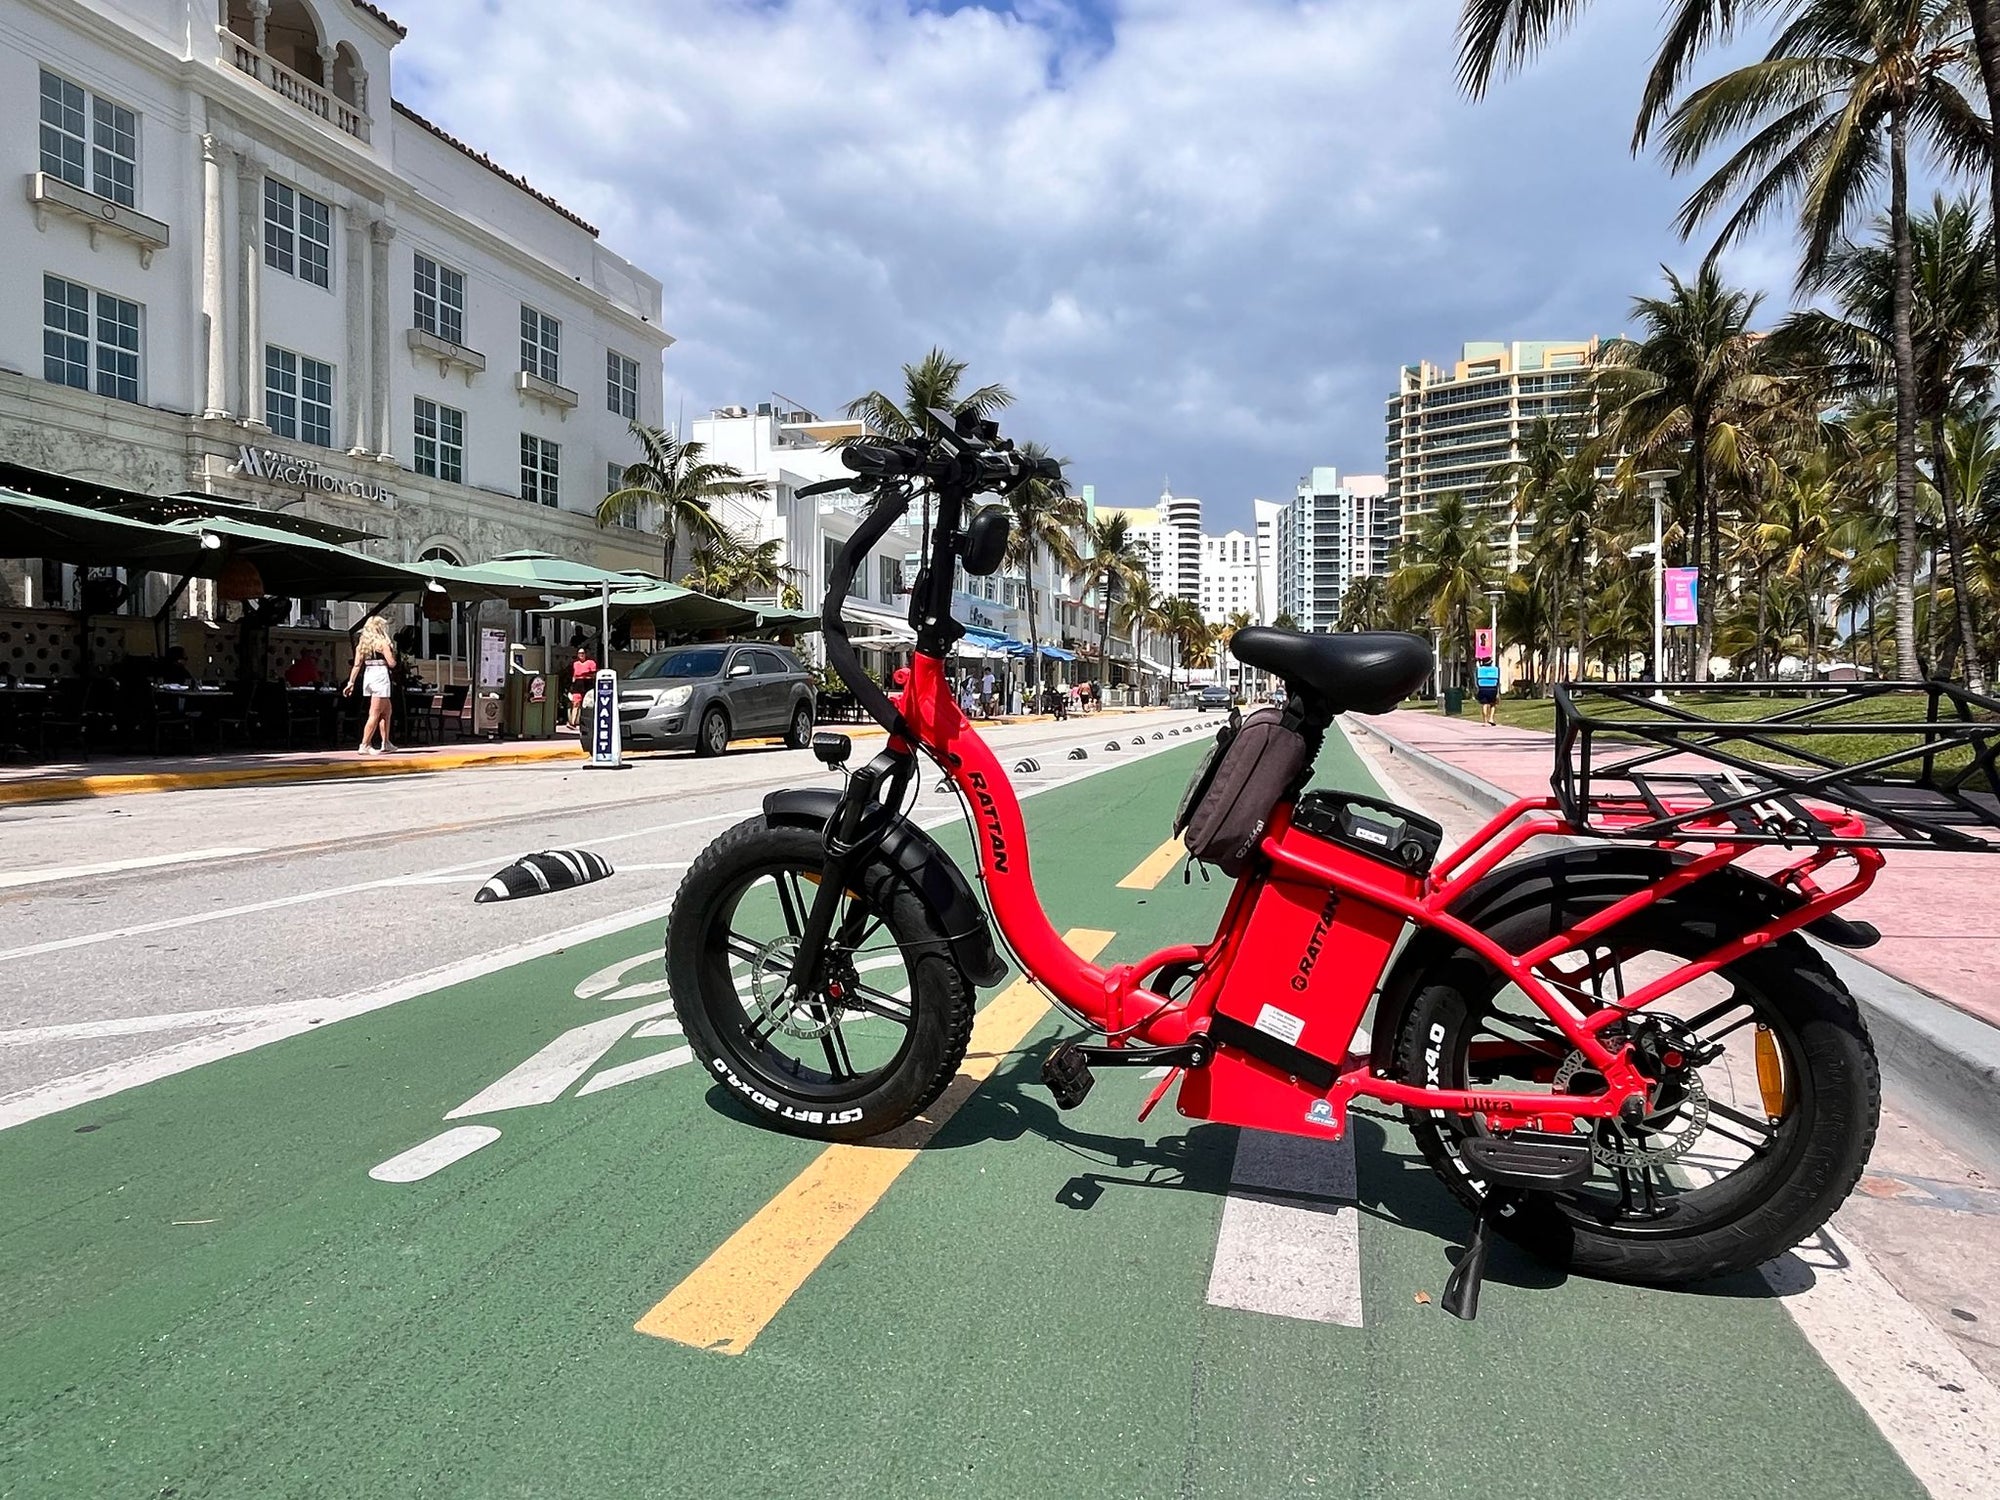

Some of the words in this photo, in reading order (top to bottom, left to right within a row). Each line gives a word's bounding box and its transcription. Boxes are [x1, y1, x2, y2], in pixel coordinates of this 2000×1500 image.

[264, 460, 345, 493] VACATION
[348, 481, 390, 503] CLUB
[599, 696, 610, 751] VALET
[966, 771, 1009, 874] RATTAN
[1298, 892, 1340, 977] RATTAN
[781, 1106, 823, 1124] BFT
[826, 1107, 863, 1125] CST
[1463, 1097, 1513, 1112] Ultra
